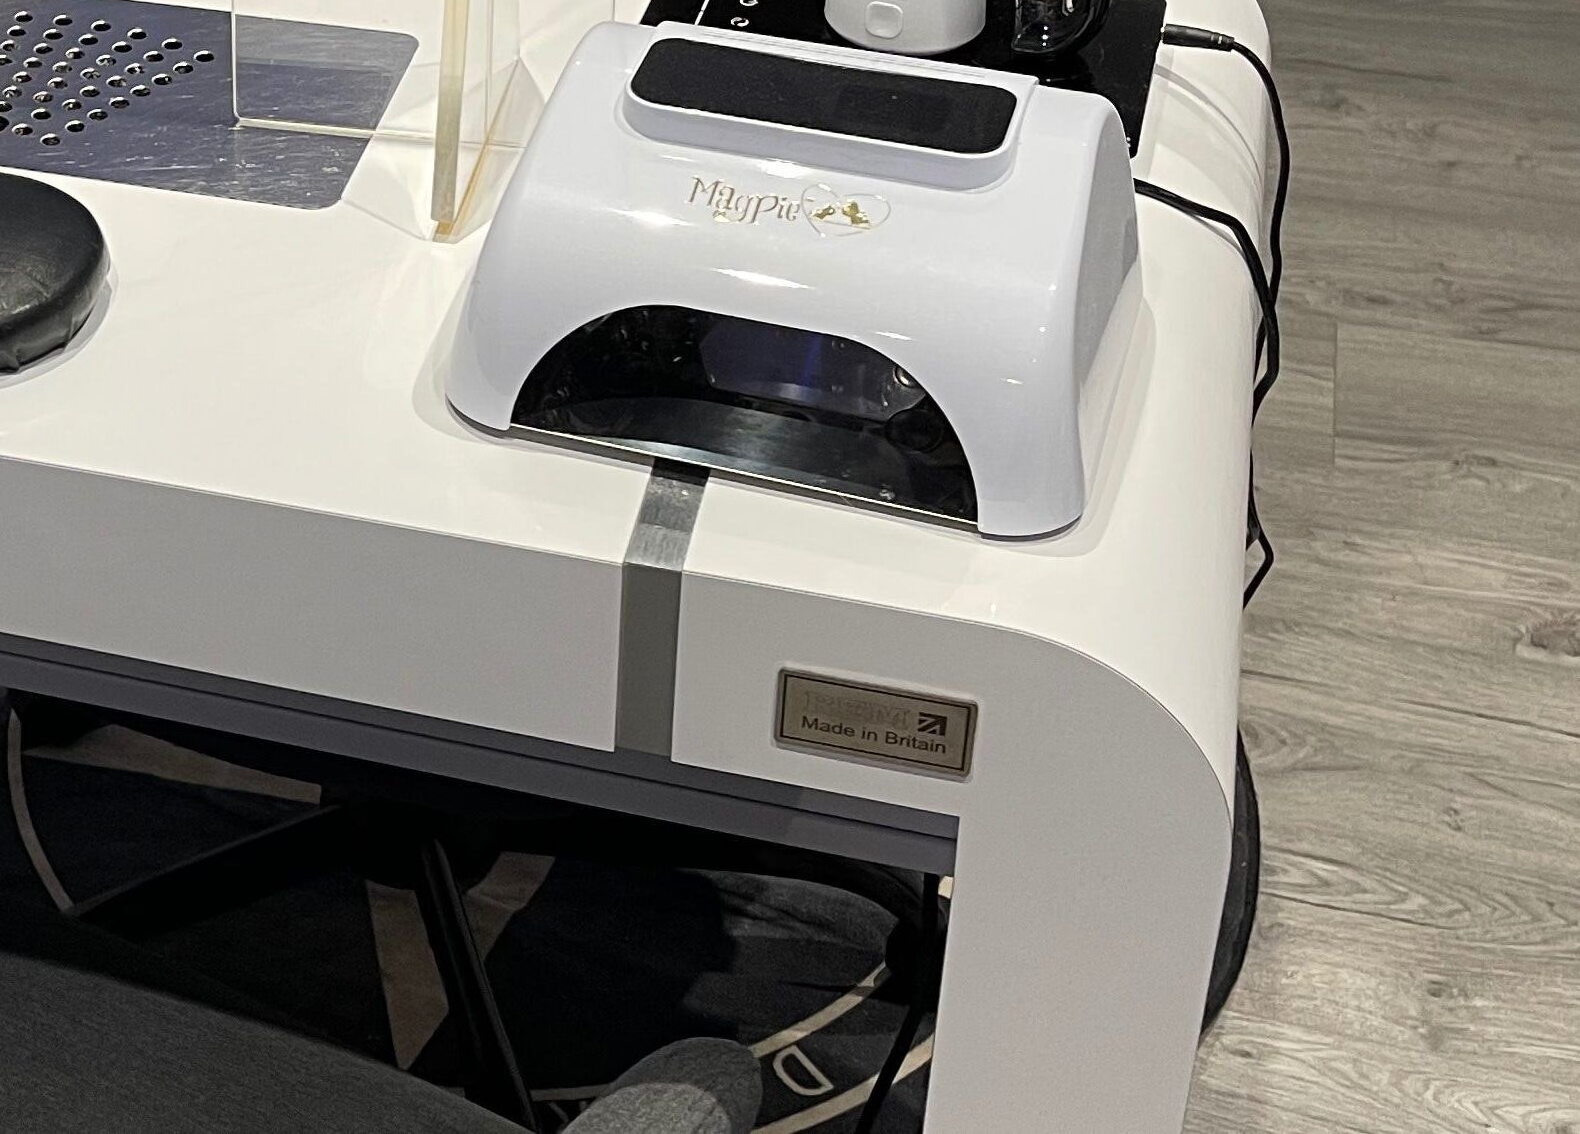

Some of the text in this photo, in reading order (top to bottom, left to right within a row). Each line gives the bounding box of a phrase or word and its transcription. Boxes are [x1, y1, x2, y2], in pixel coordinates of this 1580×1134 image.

[687, 177, 801, 224] Magpie
[801, 715, 946, 754] Made in Britain
